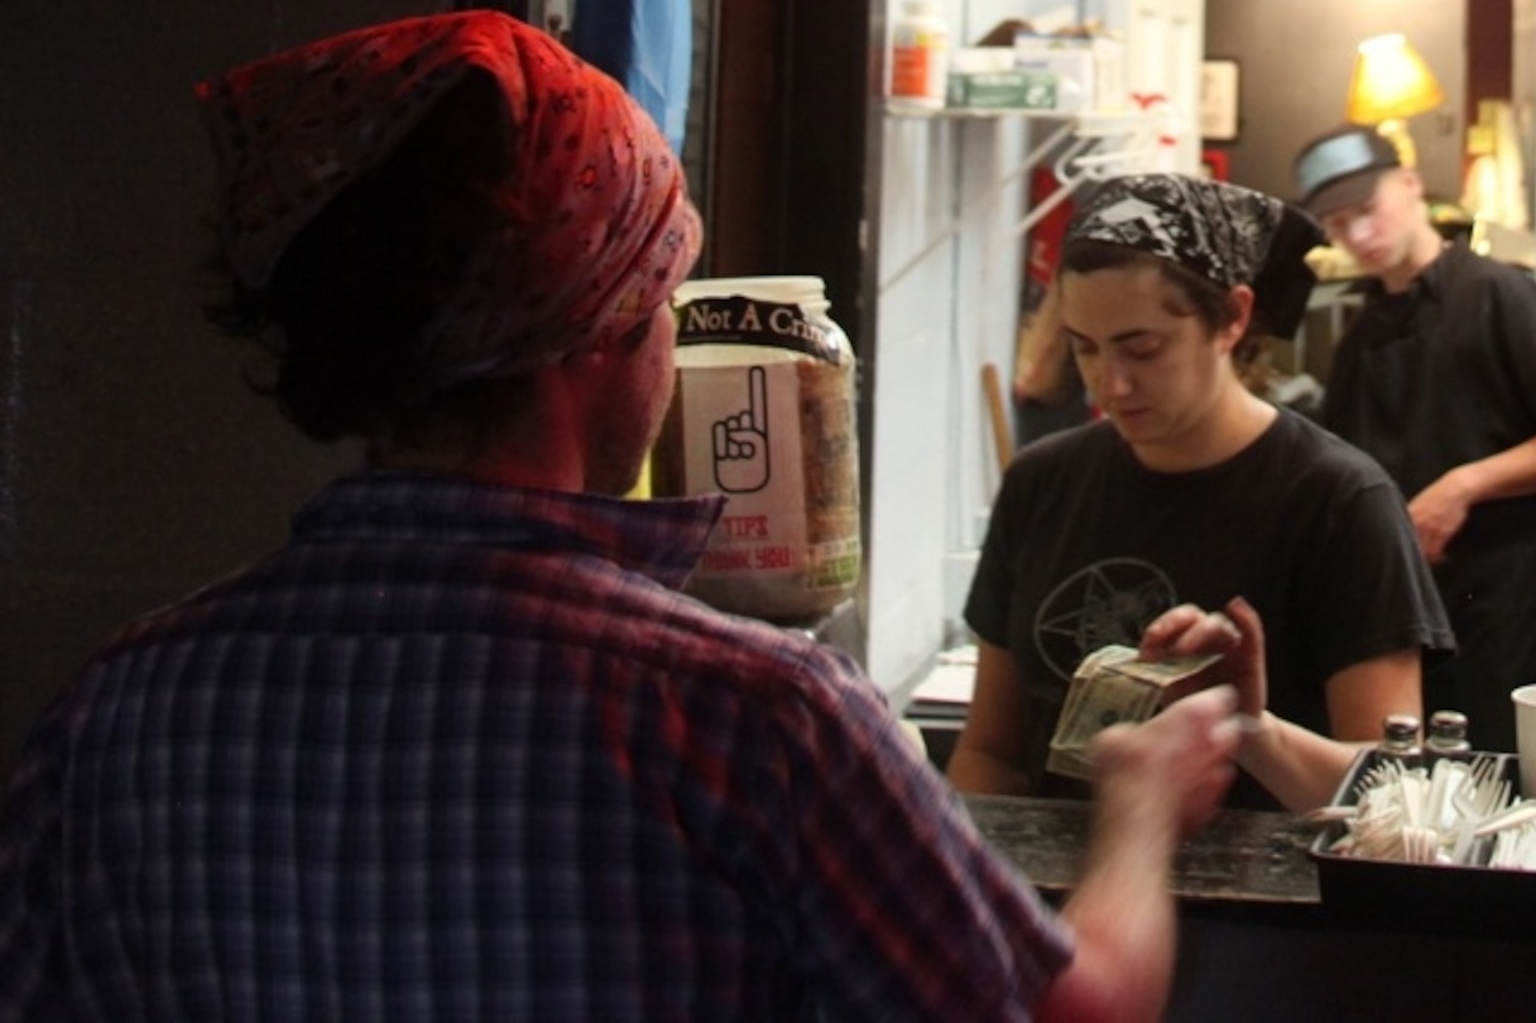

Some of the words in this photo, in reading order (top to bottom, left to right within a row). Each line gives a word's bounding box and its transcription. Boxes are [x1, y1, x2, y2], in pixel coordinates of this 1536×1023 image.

[686, 303, 732, 332] Not
[739, 303, 763, 332] A
[722, 515, 769, 537] TIPS
